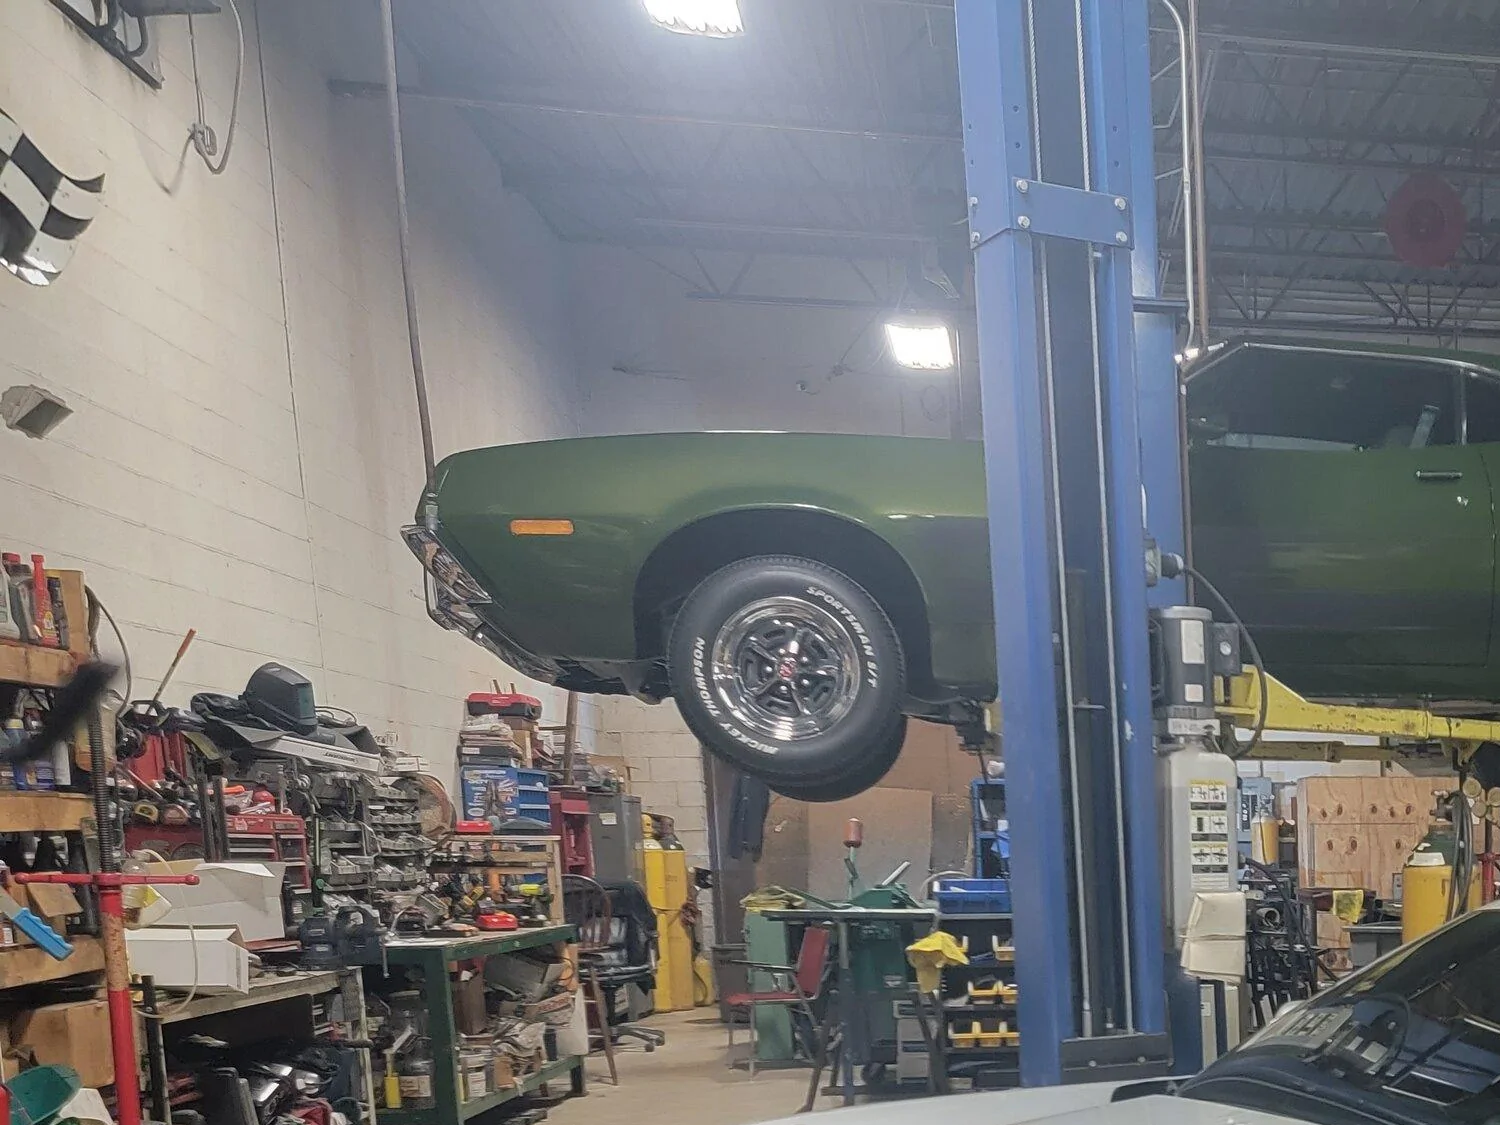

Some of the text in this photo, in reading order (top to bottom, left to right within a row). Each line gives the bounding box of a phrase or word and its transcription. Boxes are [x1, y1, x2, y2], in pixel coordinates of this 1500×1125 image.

[806, 586, 880, 688] SPORTSMAN S/T
[691, 637, 778, 755] MICKEY THOMPSON
